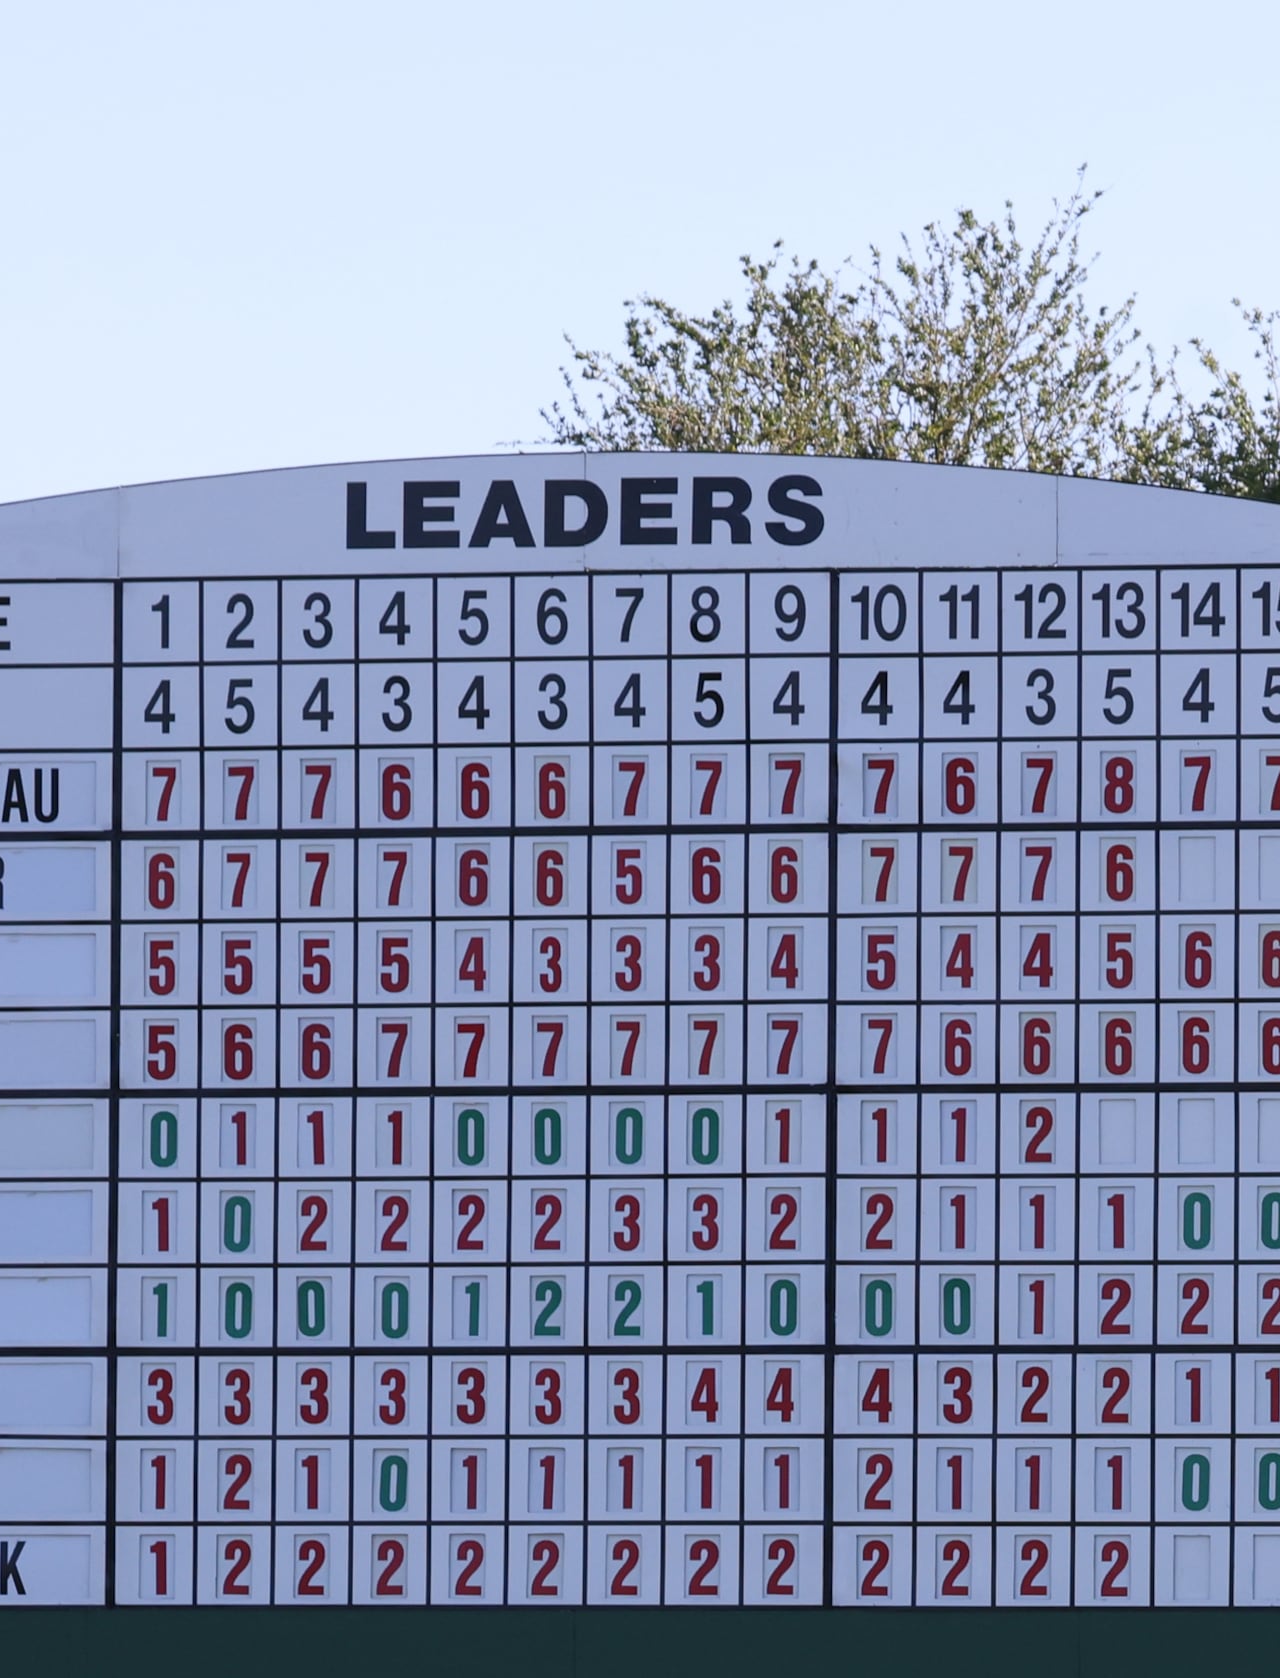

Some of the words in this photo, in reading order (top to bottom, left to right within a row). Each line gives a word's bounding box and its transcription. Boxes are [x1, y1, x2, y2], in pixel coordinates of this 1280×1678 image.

[346, 474, 825, 550] LEADERS
[151, 595, 170, 649] 1
[226, 593, 255, 649] 2
[303, 592, 333, 649] 3
[379, 591, 411, 646] 4
[458, 590, 489, 646] 5
[536, 588, 568, 645] 6
[615, 587, 644, 643] 7
[689, 586, 721, 643] 8
[774, 584, 806, 642] 9
[851, 584, 907, 642] 10
[939, 584, 980, 640] 11
[1014, 582, 1067, 639] 12
[1091, 581, 1146, 639] 13
[1171, 582, 1226, 637] 14
[144, 679, 176, 734] 4
[224, 678, 255, 735] 5
[302, 677, 334, 732] 4
[382, 675, 412, 732] 3
[458, 675, 490, 730] 4
[537, 673, 568, 730] 3
[614, 673, 646, 728] 4
[694, 671, 725, 728] 5
[773, 671, 805, 726] 4
[861, 670, 893, 726] 4
[943, 670, 976, 725] 4
[1025, 668, 1056, 726] 3
[1103, 668, 1134, 725] 5
[1182, 668, 1215, 723] 4
[153, 768, 176, 821] 7
[228, 766, 254, 820] 7
[306, 765, 331, 819] 7
[382, 764, 411, 820] 6
[461, 763, 489, 819] 6
[539, 763, 565, 819] 6
[619, 762, 645, 816] 7
[696, 761, 722, 815] 7
[775, 760, 801, 814] 7
[868, 760, 894, 814] 7
[946, 758, 975, 814] 6
[1027, 759, 1053, 813] 7
[1104, 757, 1133, 813] 8
[1184, 756, 1211, 811] 7
[151, 1111, 178, 1167] 0
[232, 1112, 246, 1165] 1
[307, 1111, 324, 1164] 1
[388, 1111, 402, 1165] 1
[458, 1109, 484, 1166] 0
[535, 1109, 561, 1165] 0
[616, 1108, 643, 1164] 0
[692, 1108, 719, 1165] 0
[776, 1109, 790, 1163] 1
[872, 1108, 887, 1162] 1
[952, 1108, 966, 1162] 1
[1025, 1107, 1053, 1163] 2
[153, 1283, 167, 1337] 1
[225, 1282, 252, 1338] 0
[297, 1280, 325, 1337] 0
[382, 1282, 409, 1339] 0
[465, 1282, 480, 1336] 1
[534, 1280, 562, 1336] 2
[614, 1280, 641, 1336] 2
[697, 1281, 713, 1335] 1
[770, 1279, 797, 1336] 0
[865, 1280, 892, 1336] 0
[943, 1278, 971, 1335] 0
[1030, 1280, 1044, 1334] 1
[1101, 1279, 1131, 1334] 2
[1181, 1279, 1209, 1334] 2
[150, 1541, 166, 1595] 1
[223, 1540, 251, 1595] 2
[298, 1540, 325, 1595] 2
[376, 1540, 404, 1595] 2
[455, 1540, 483, 1595] 2
[531, 1540, 559, 1595] 2
[611, 1540, 639, 1595] 2
[689, 1540, 719, 1595] 2
[767, 1539, 795, 1595] 2
[861, 1540, 889, 1596] 2
[942, 1540, 970, 1595] 2
[1020, 1540, 1048, 1595] 2
[1101, 1541, 1128, 1596] 2
